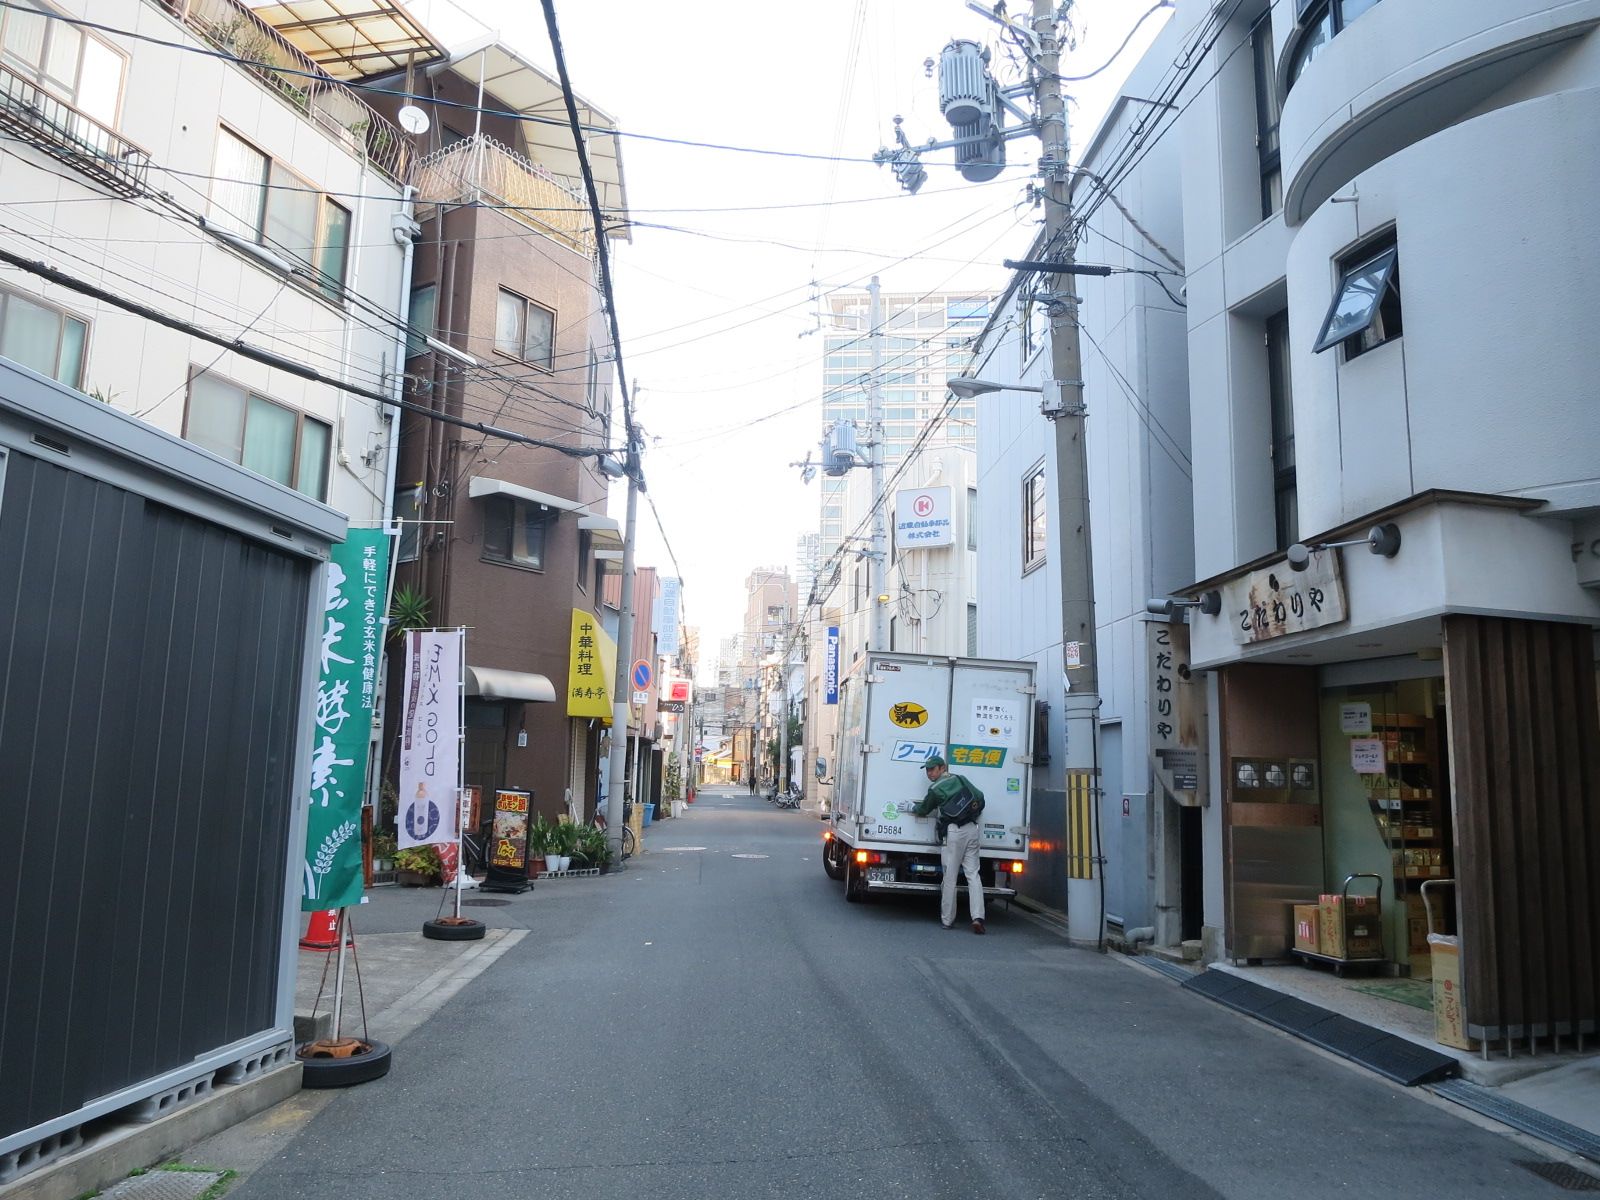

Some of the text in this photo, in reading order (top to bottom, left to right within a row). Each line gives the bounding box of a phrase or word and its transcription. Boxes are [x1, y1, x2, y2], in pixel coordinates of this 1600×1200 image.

[908, 530, 941, 540] 株式会社
[361, 546, 377, 709] 手軽にできる玄米食健康法
[1240, 588, 1324, 631] こだわりや
[577, 622, 593, 676] 中華料理
[828, 636, 838, 695] Panasonic
[572, 687, 605, 700] 満寿亭
[1156, 630, 1172, 740] こだわりや
[898, 744, 1002, 766] クール 宅急便
[878, 824, 902, 835] D5684
